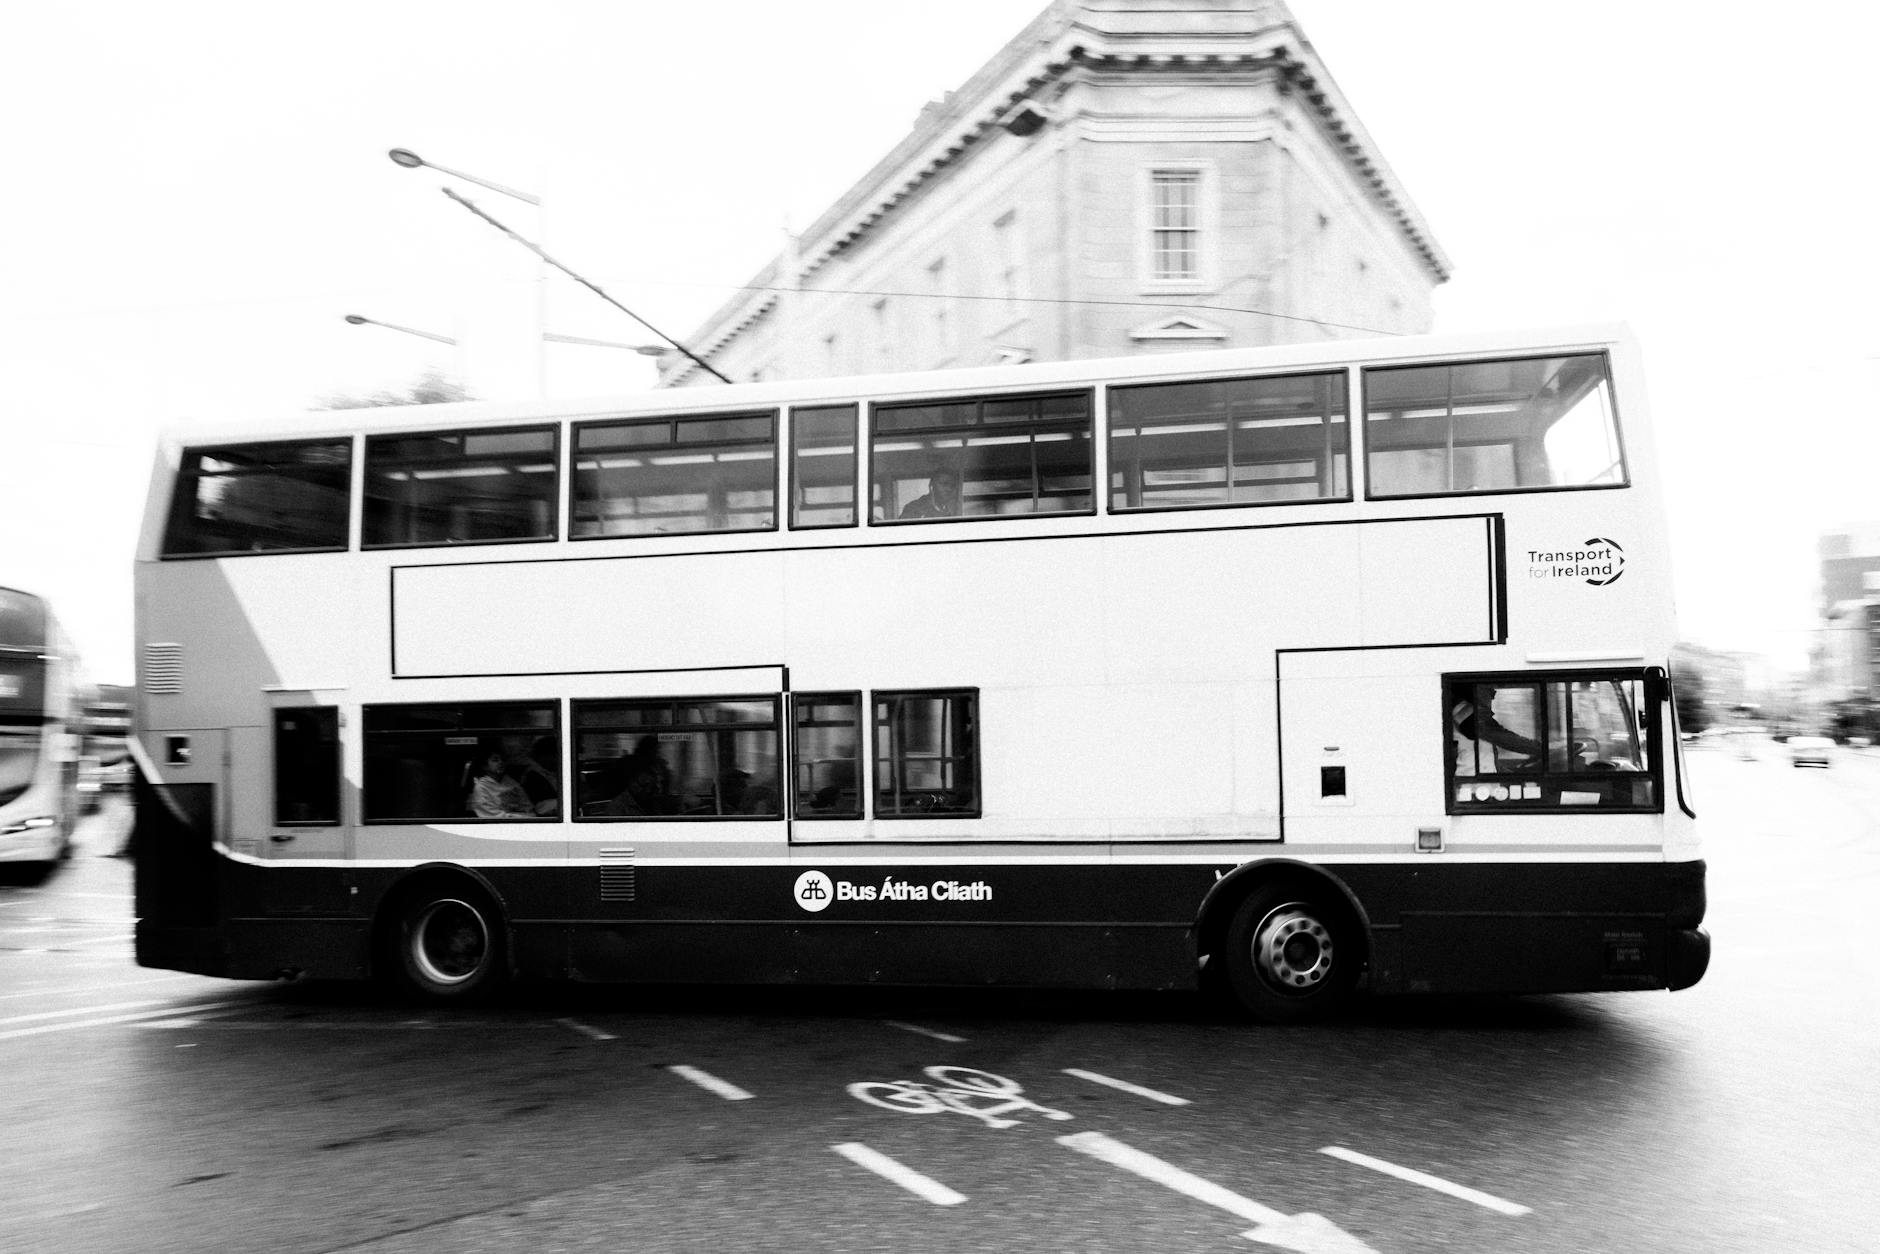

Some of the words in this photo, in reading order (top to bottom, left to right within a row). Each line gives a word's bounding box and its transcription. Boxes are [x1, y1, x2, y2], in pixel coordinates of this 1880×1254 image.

[1528, 548, 1612, 563] Transport
[1529, 567, 1549, 579] for
[1552, 563, 1612, 577] Ireland
[836, 880, 877, 901] Bus
[879, 876, 928, 901] Átha
[931, 880, 993, 901] Cliath
